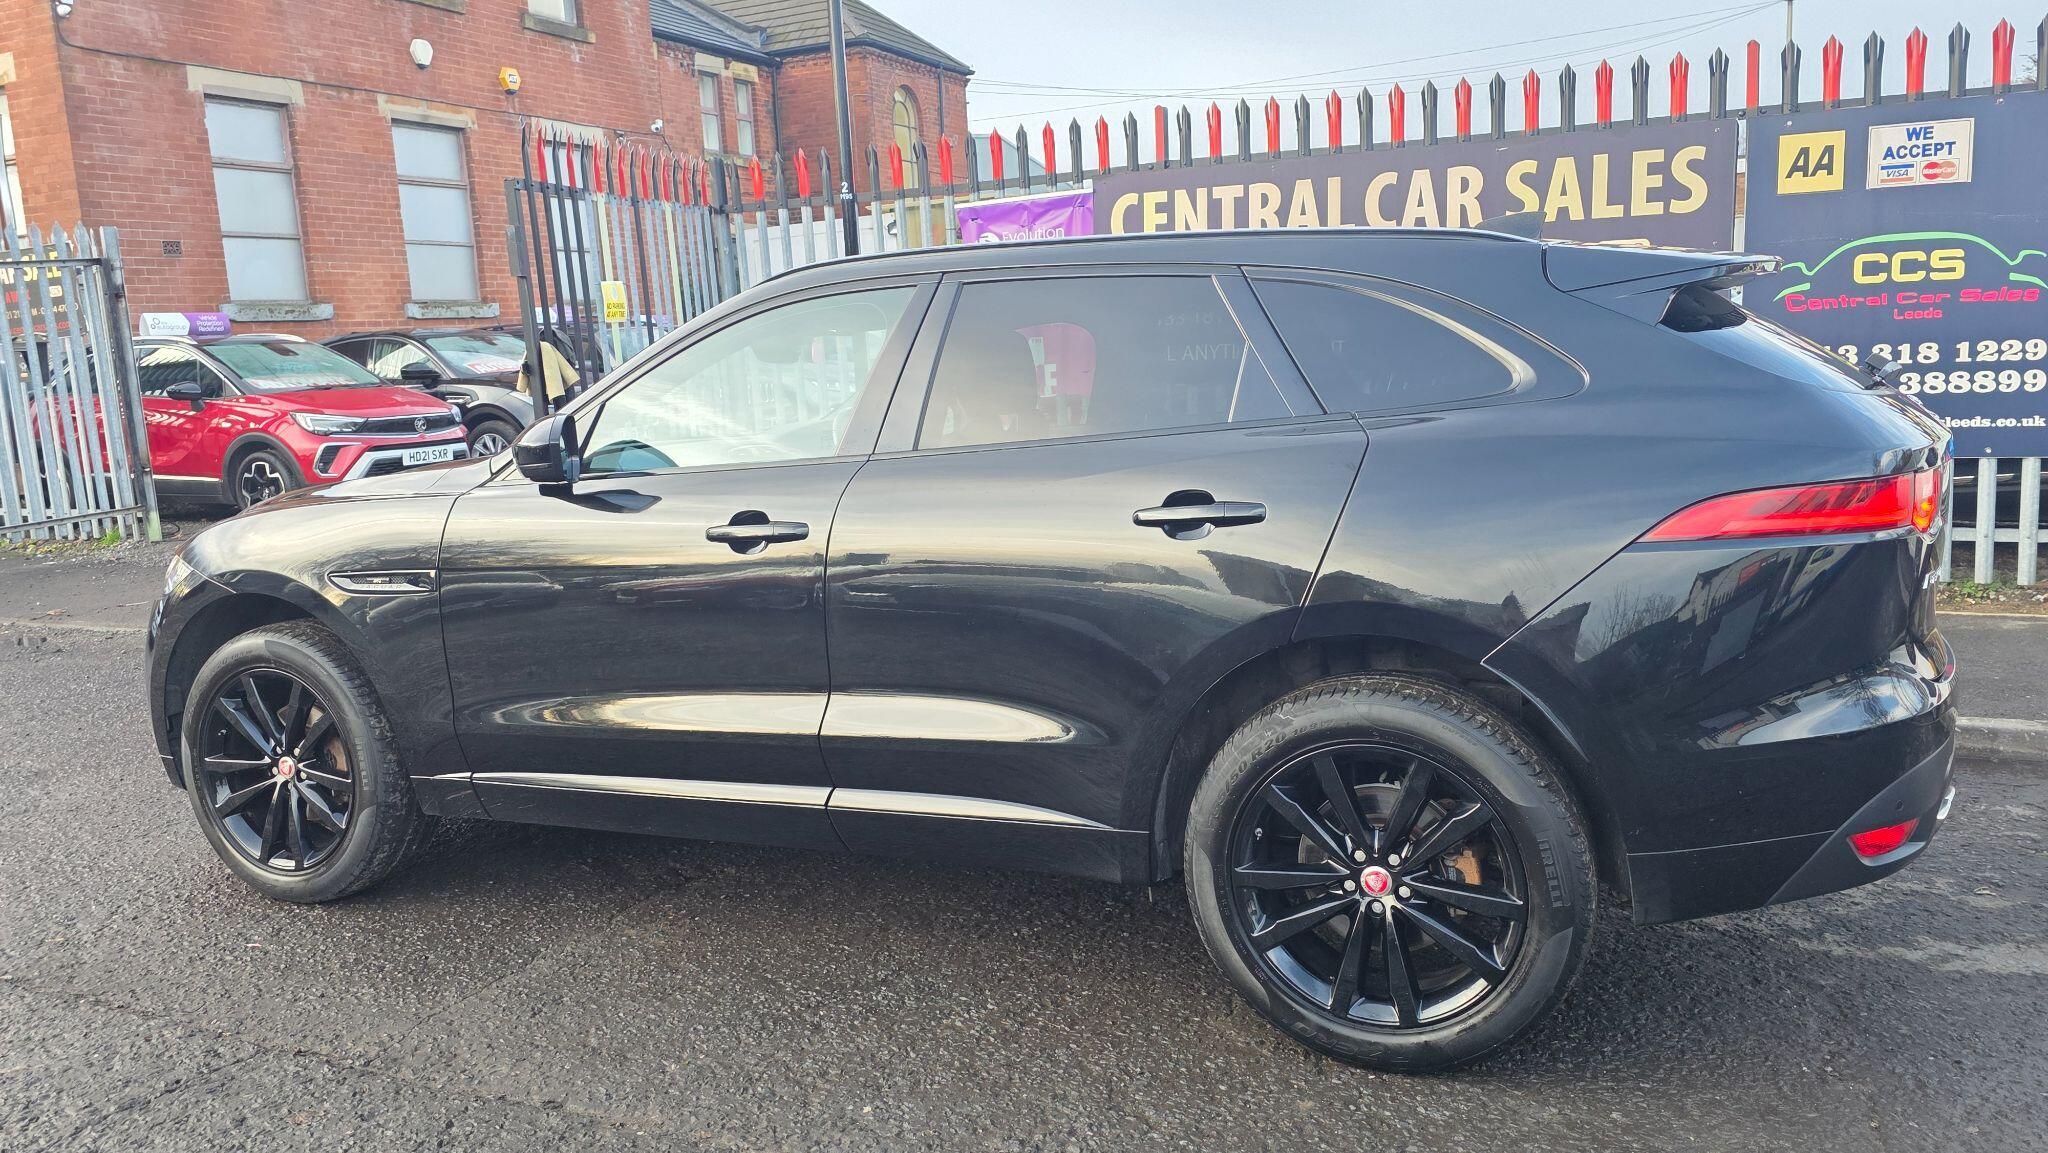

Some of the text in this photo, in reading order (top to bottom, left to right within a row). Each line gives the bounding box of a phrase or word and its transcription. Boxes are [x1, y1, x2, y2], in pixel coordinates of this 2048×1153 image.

[1906, 126, 1934, 141] WE
[1882, 141, 1957, 160] ACCEPT
[1786, 144, 1835, 180] AA
[1886, 168, 1909, 178] VISA
[841, 181, 849, 193] 2
[1110, 145, 1709, 236] CENTRAL CAR SALES
[1002, 226, 1065, 241] Evolution
[1853, 248, 1966, 285] CCS
[1785, 285, 2041, 313] Central Car Sales
[1893, 307, 1944, 321] Leeds
[1955, 338, 2048, 363] 1229
[1899, 369, 2047, 395] 388899
[409, 448, 448, 463] HD21 SXR
